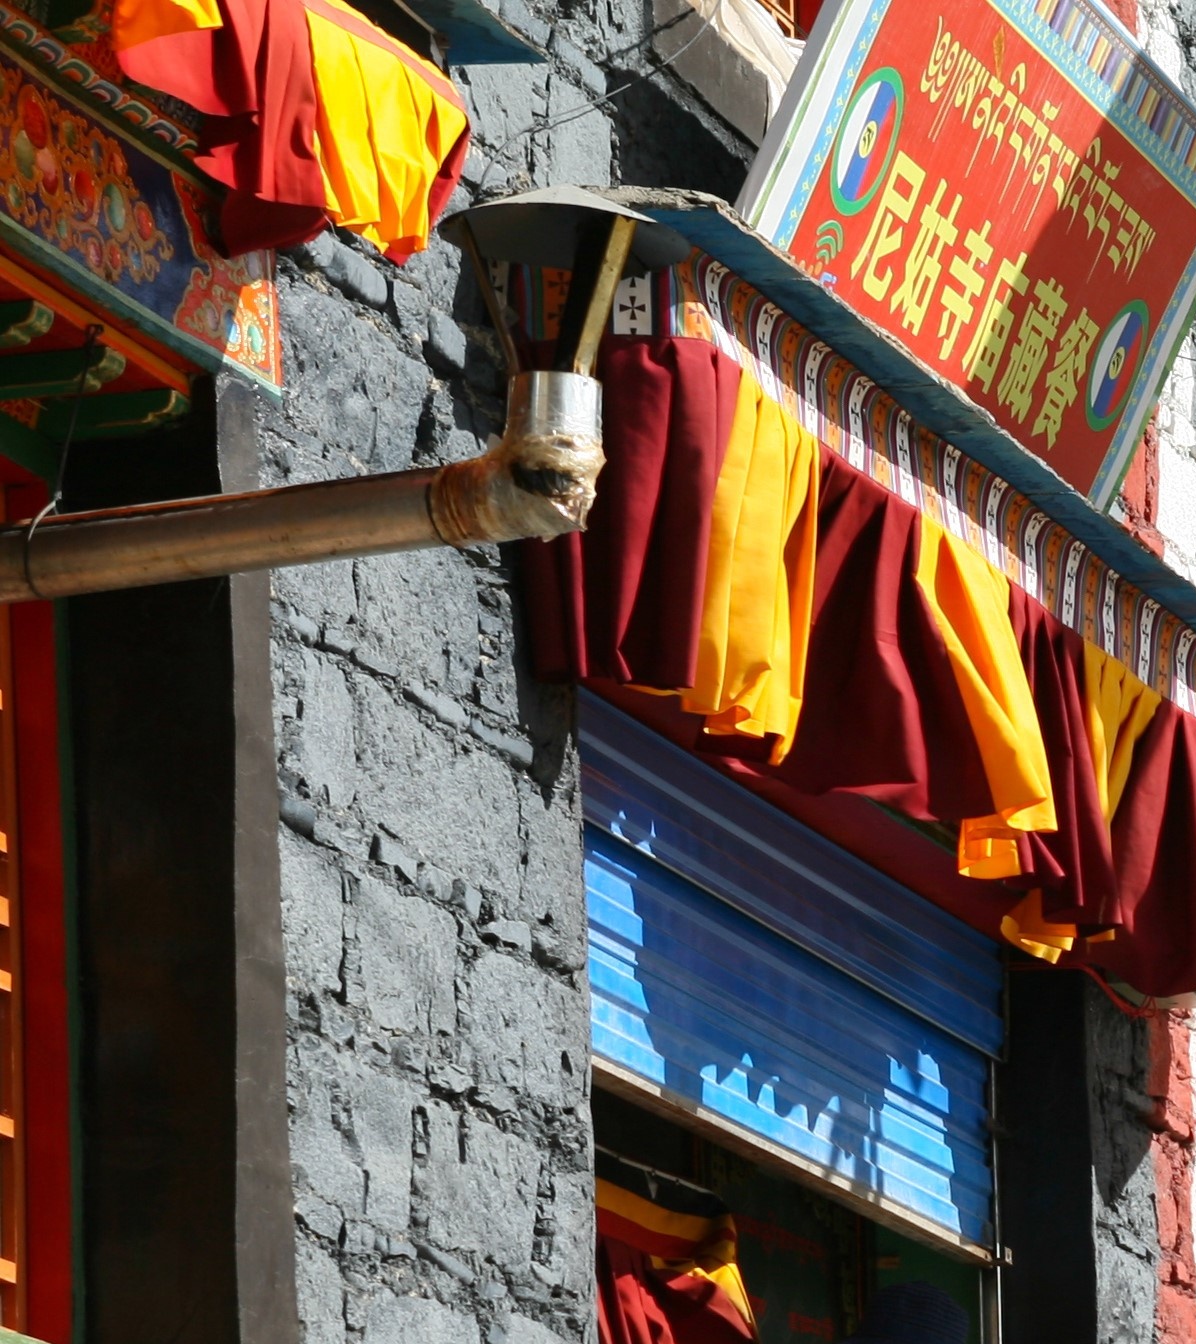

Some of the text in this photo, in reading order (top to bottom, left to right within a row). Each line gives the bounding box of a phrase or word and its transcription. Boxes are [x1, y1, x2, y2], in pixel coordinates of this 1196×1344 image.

[851, 149, 1101, 451] 尼姑寺庙藏餐
